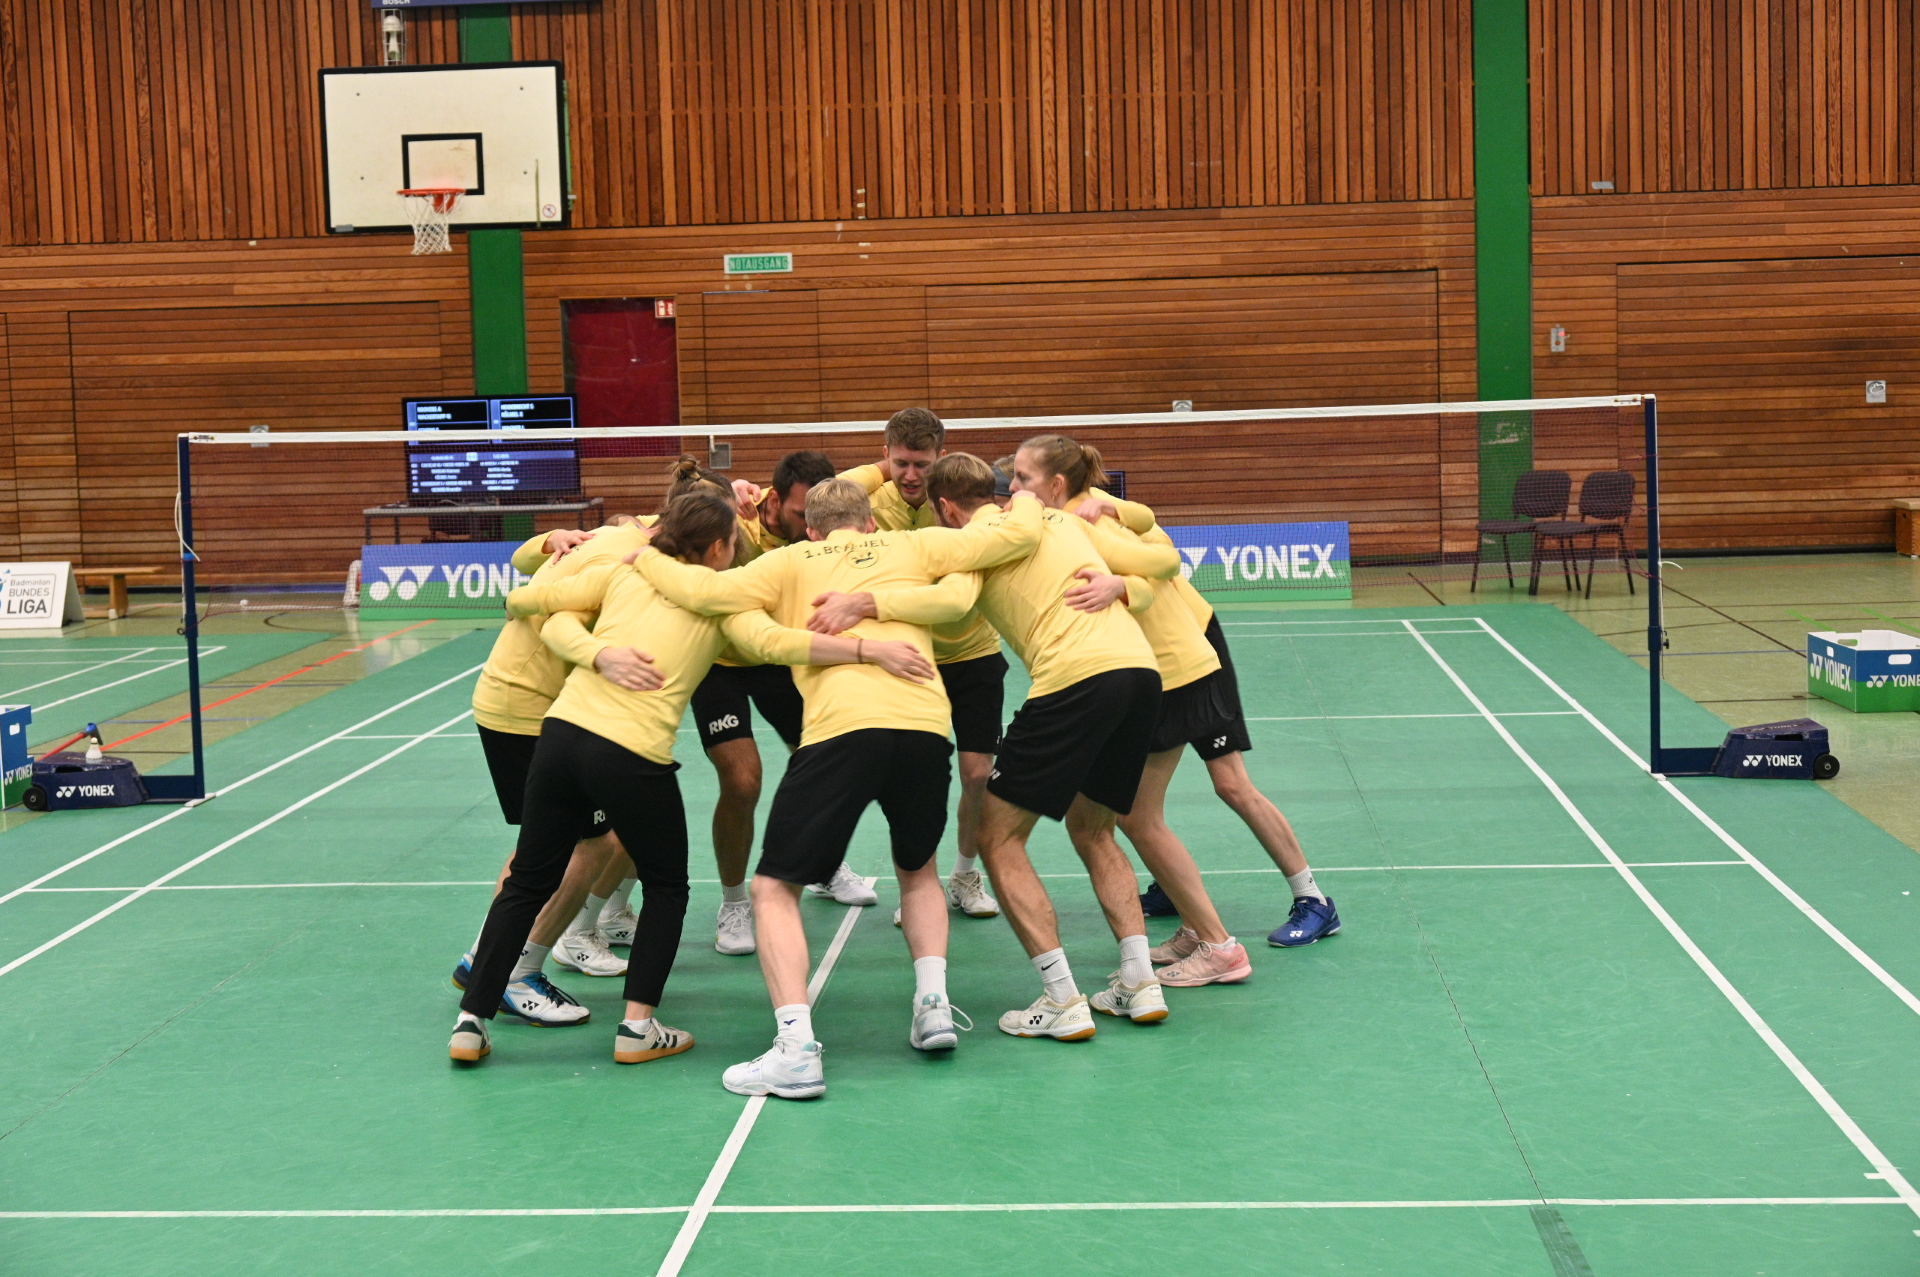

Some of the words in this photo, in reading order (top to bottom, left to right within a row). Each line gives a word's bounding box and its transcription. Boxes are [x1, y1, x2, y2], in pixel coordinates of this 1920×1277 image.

[729, 257, 788, 270] NOTAUSGANG
[1216, 544, 1337, 581] YONEX
[10, 579, 51, 587] Badminton
[9, 587, 50, 597] BUNDES
[7, 598, 47, 614] LIGA
[1824, 657, 1851, 692] YONEX
[709, 714, 739, 735] RKG
[1765, 754, 1803, 767] YONEX
[15, 762, 34, 782] YONEX
[78, 784, 115, 797] YONEX
